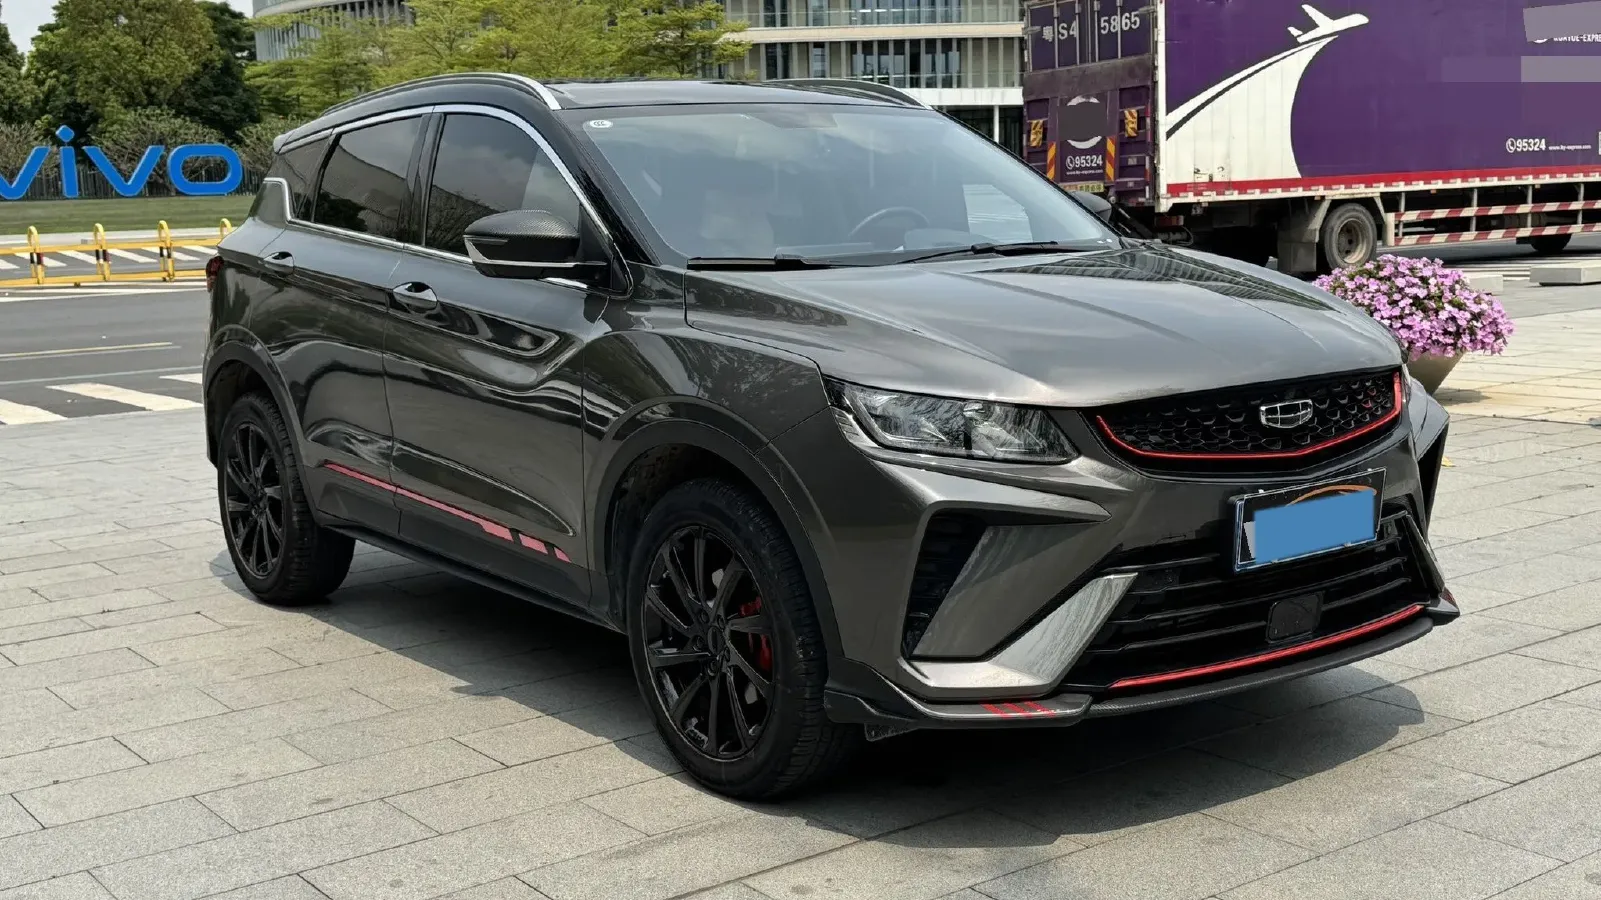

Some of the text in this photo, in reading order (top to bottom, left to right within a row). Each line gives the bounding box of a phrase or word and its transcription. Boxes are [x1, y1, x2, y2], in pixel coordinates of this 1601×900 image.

[1100, 11, 1140, 35] 5865
[1516, 138, 1546, 152] 95324
[0, 124, 243, 200] vivo
[1075, 155, 1103, 168] 95324
